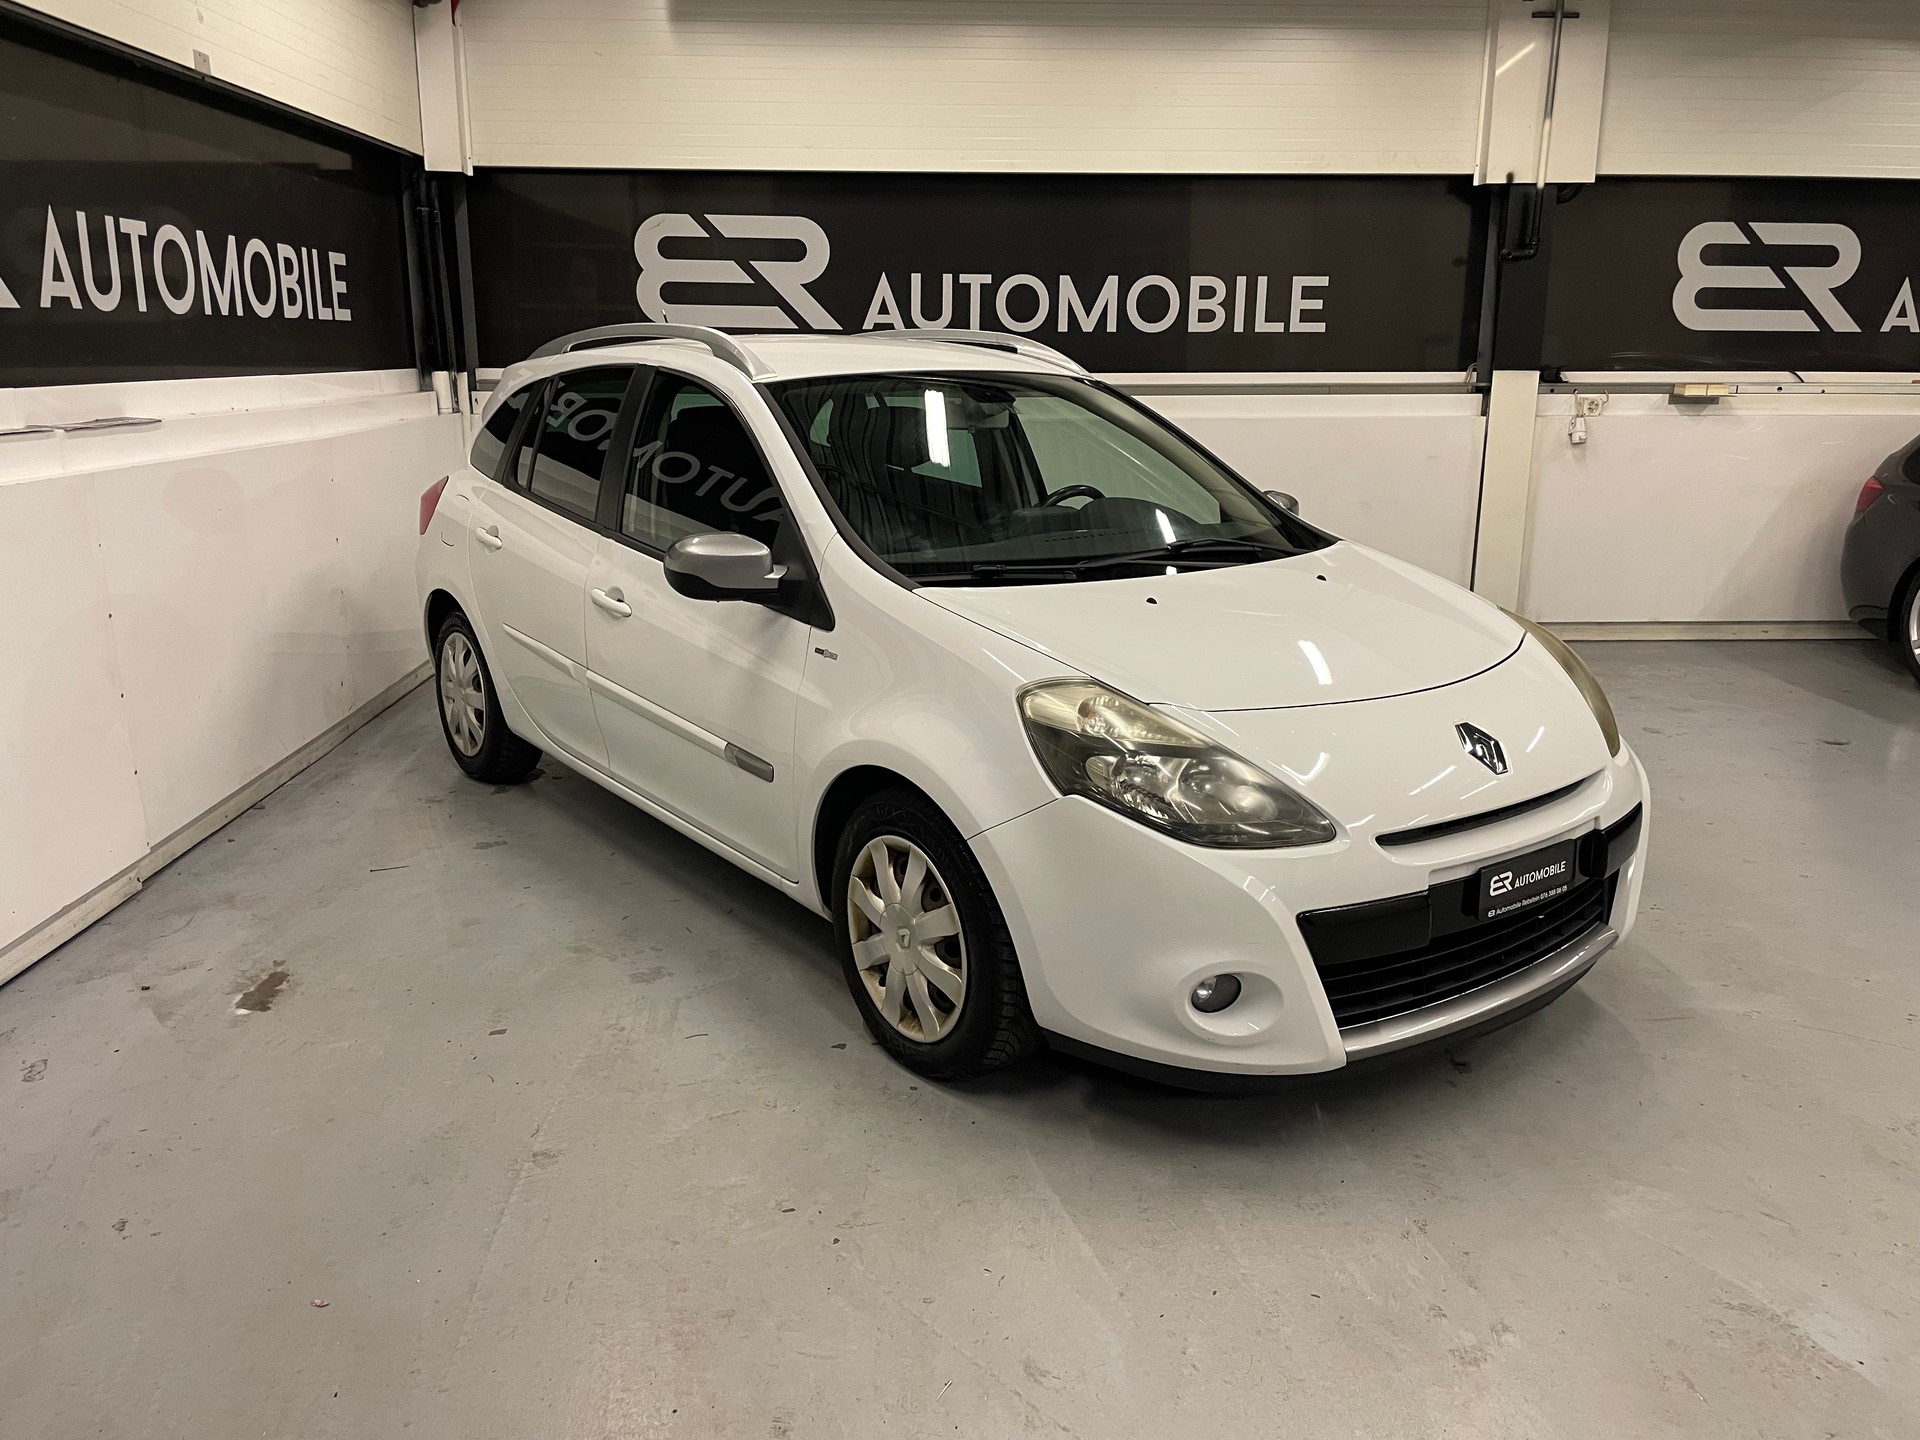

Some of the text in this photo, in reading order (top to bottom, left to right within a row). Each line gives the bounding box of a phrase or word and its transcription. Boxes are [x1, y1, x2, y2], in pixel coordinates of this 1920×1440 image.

[40, 204, 352, 321] AUTOMOBILE
[634, 213, 1330, 333] ER AUTOMOBILE
[1672, 221, 1863, 332] ER
[1490, 861, 1567, 897] ER AUTOMOBILE
[1496, 902, 1521, 915] Automobile
